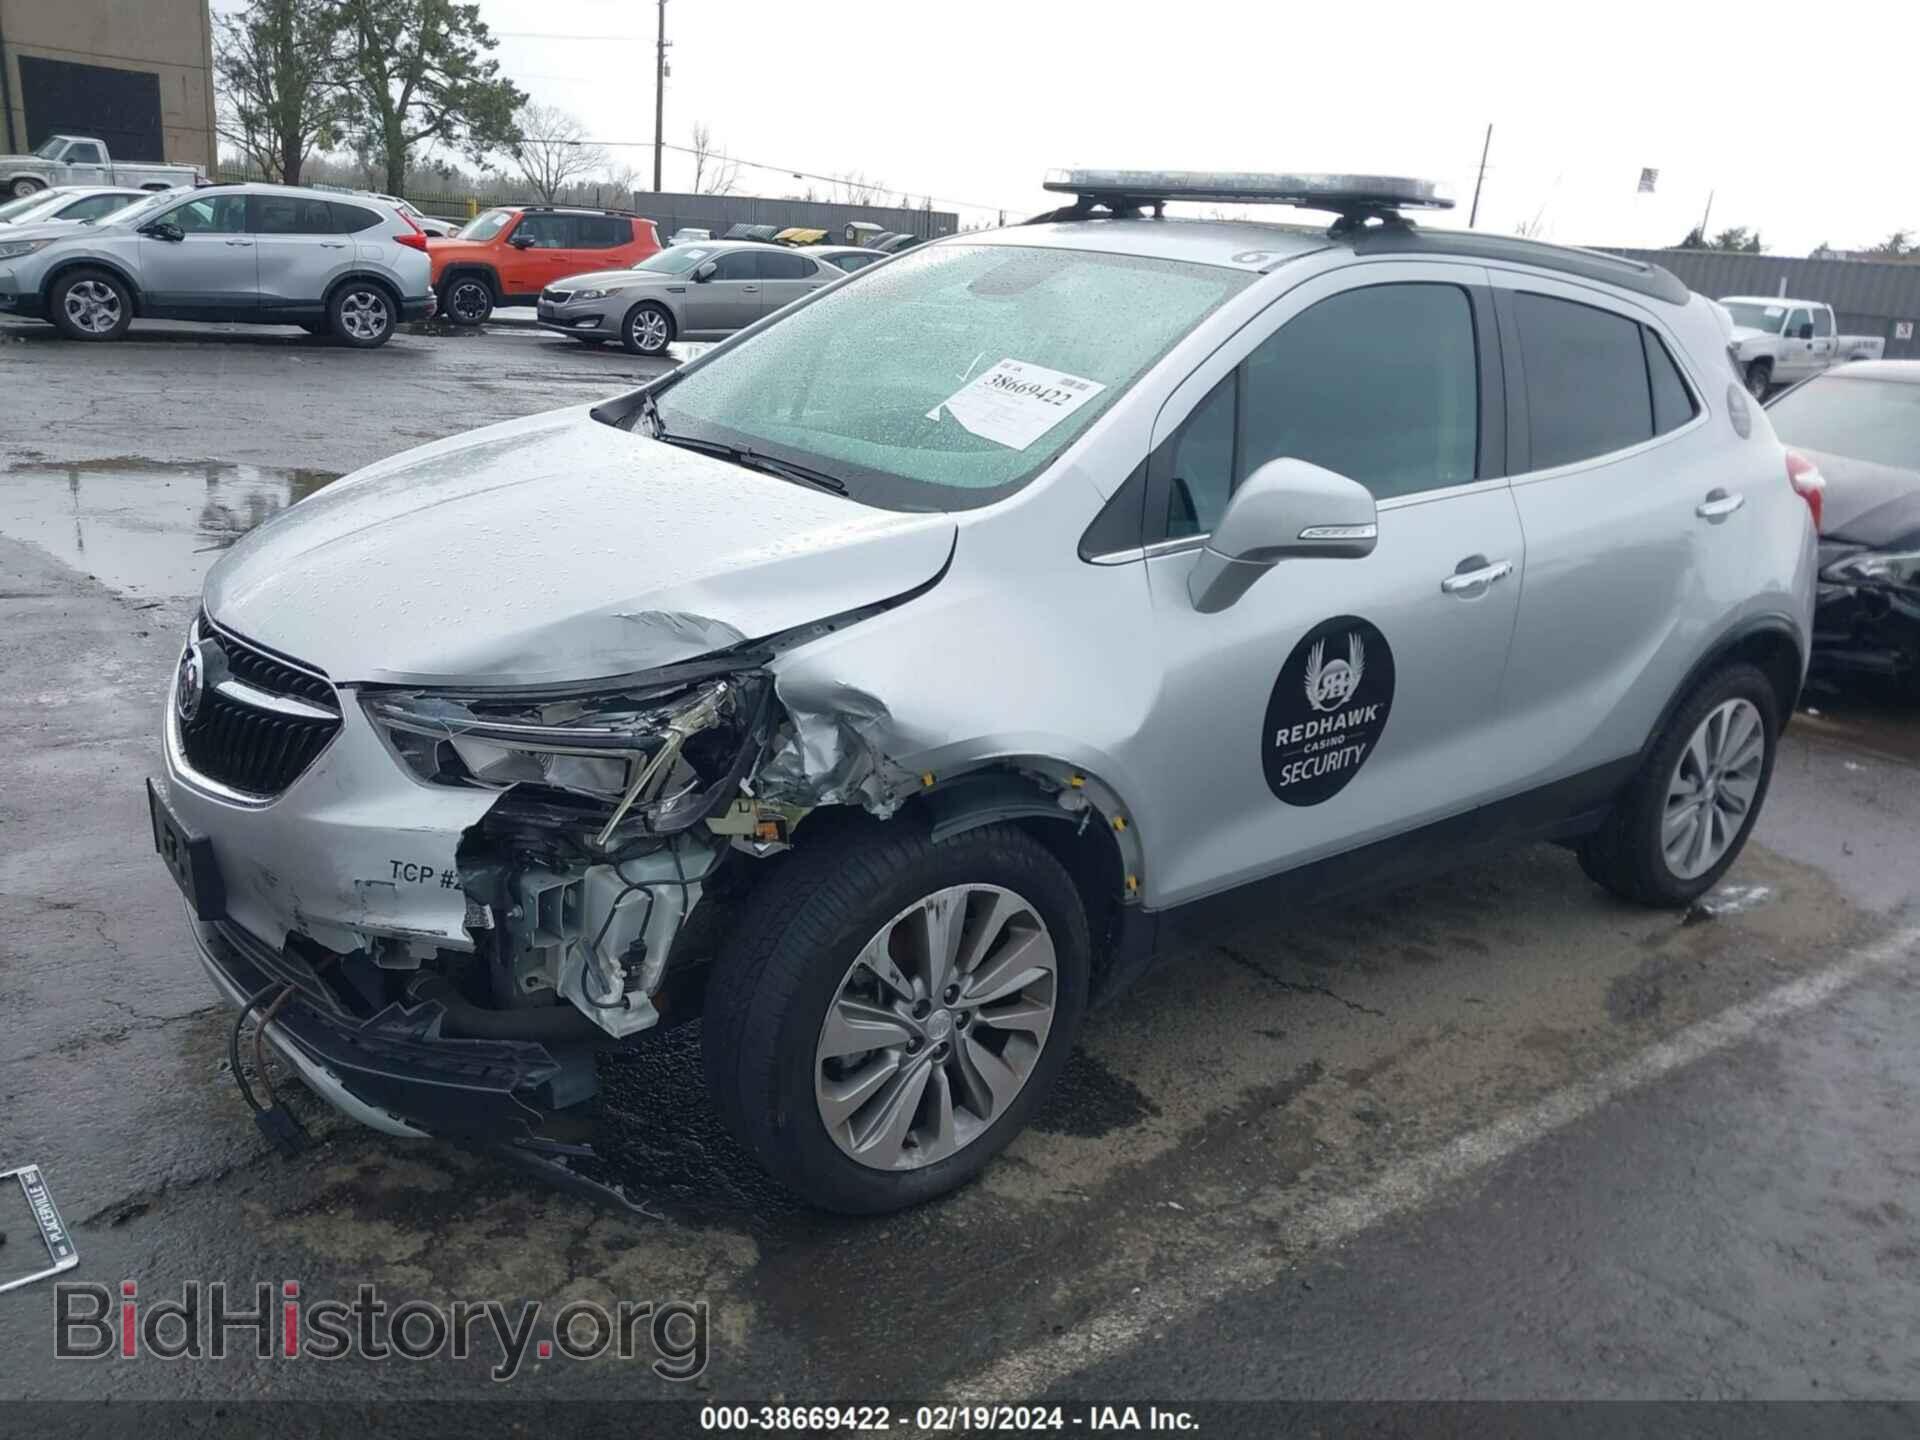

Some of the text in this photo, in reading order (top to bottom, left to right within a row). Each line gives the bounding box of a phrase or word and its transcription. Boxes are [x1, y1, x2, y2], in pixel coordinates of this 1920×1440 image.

[984, 373, 1073, 406] 38669422
[1275, 704, 1377, 747] REDHAWK
[1303, 734, 1346, 753] CASINO
[1279, 743, 1367, 786] SECURITY
[390, 860, 434, 884] TCP
